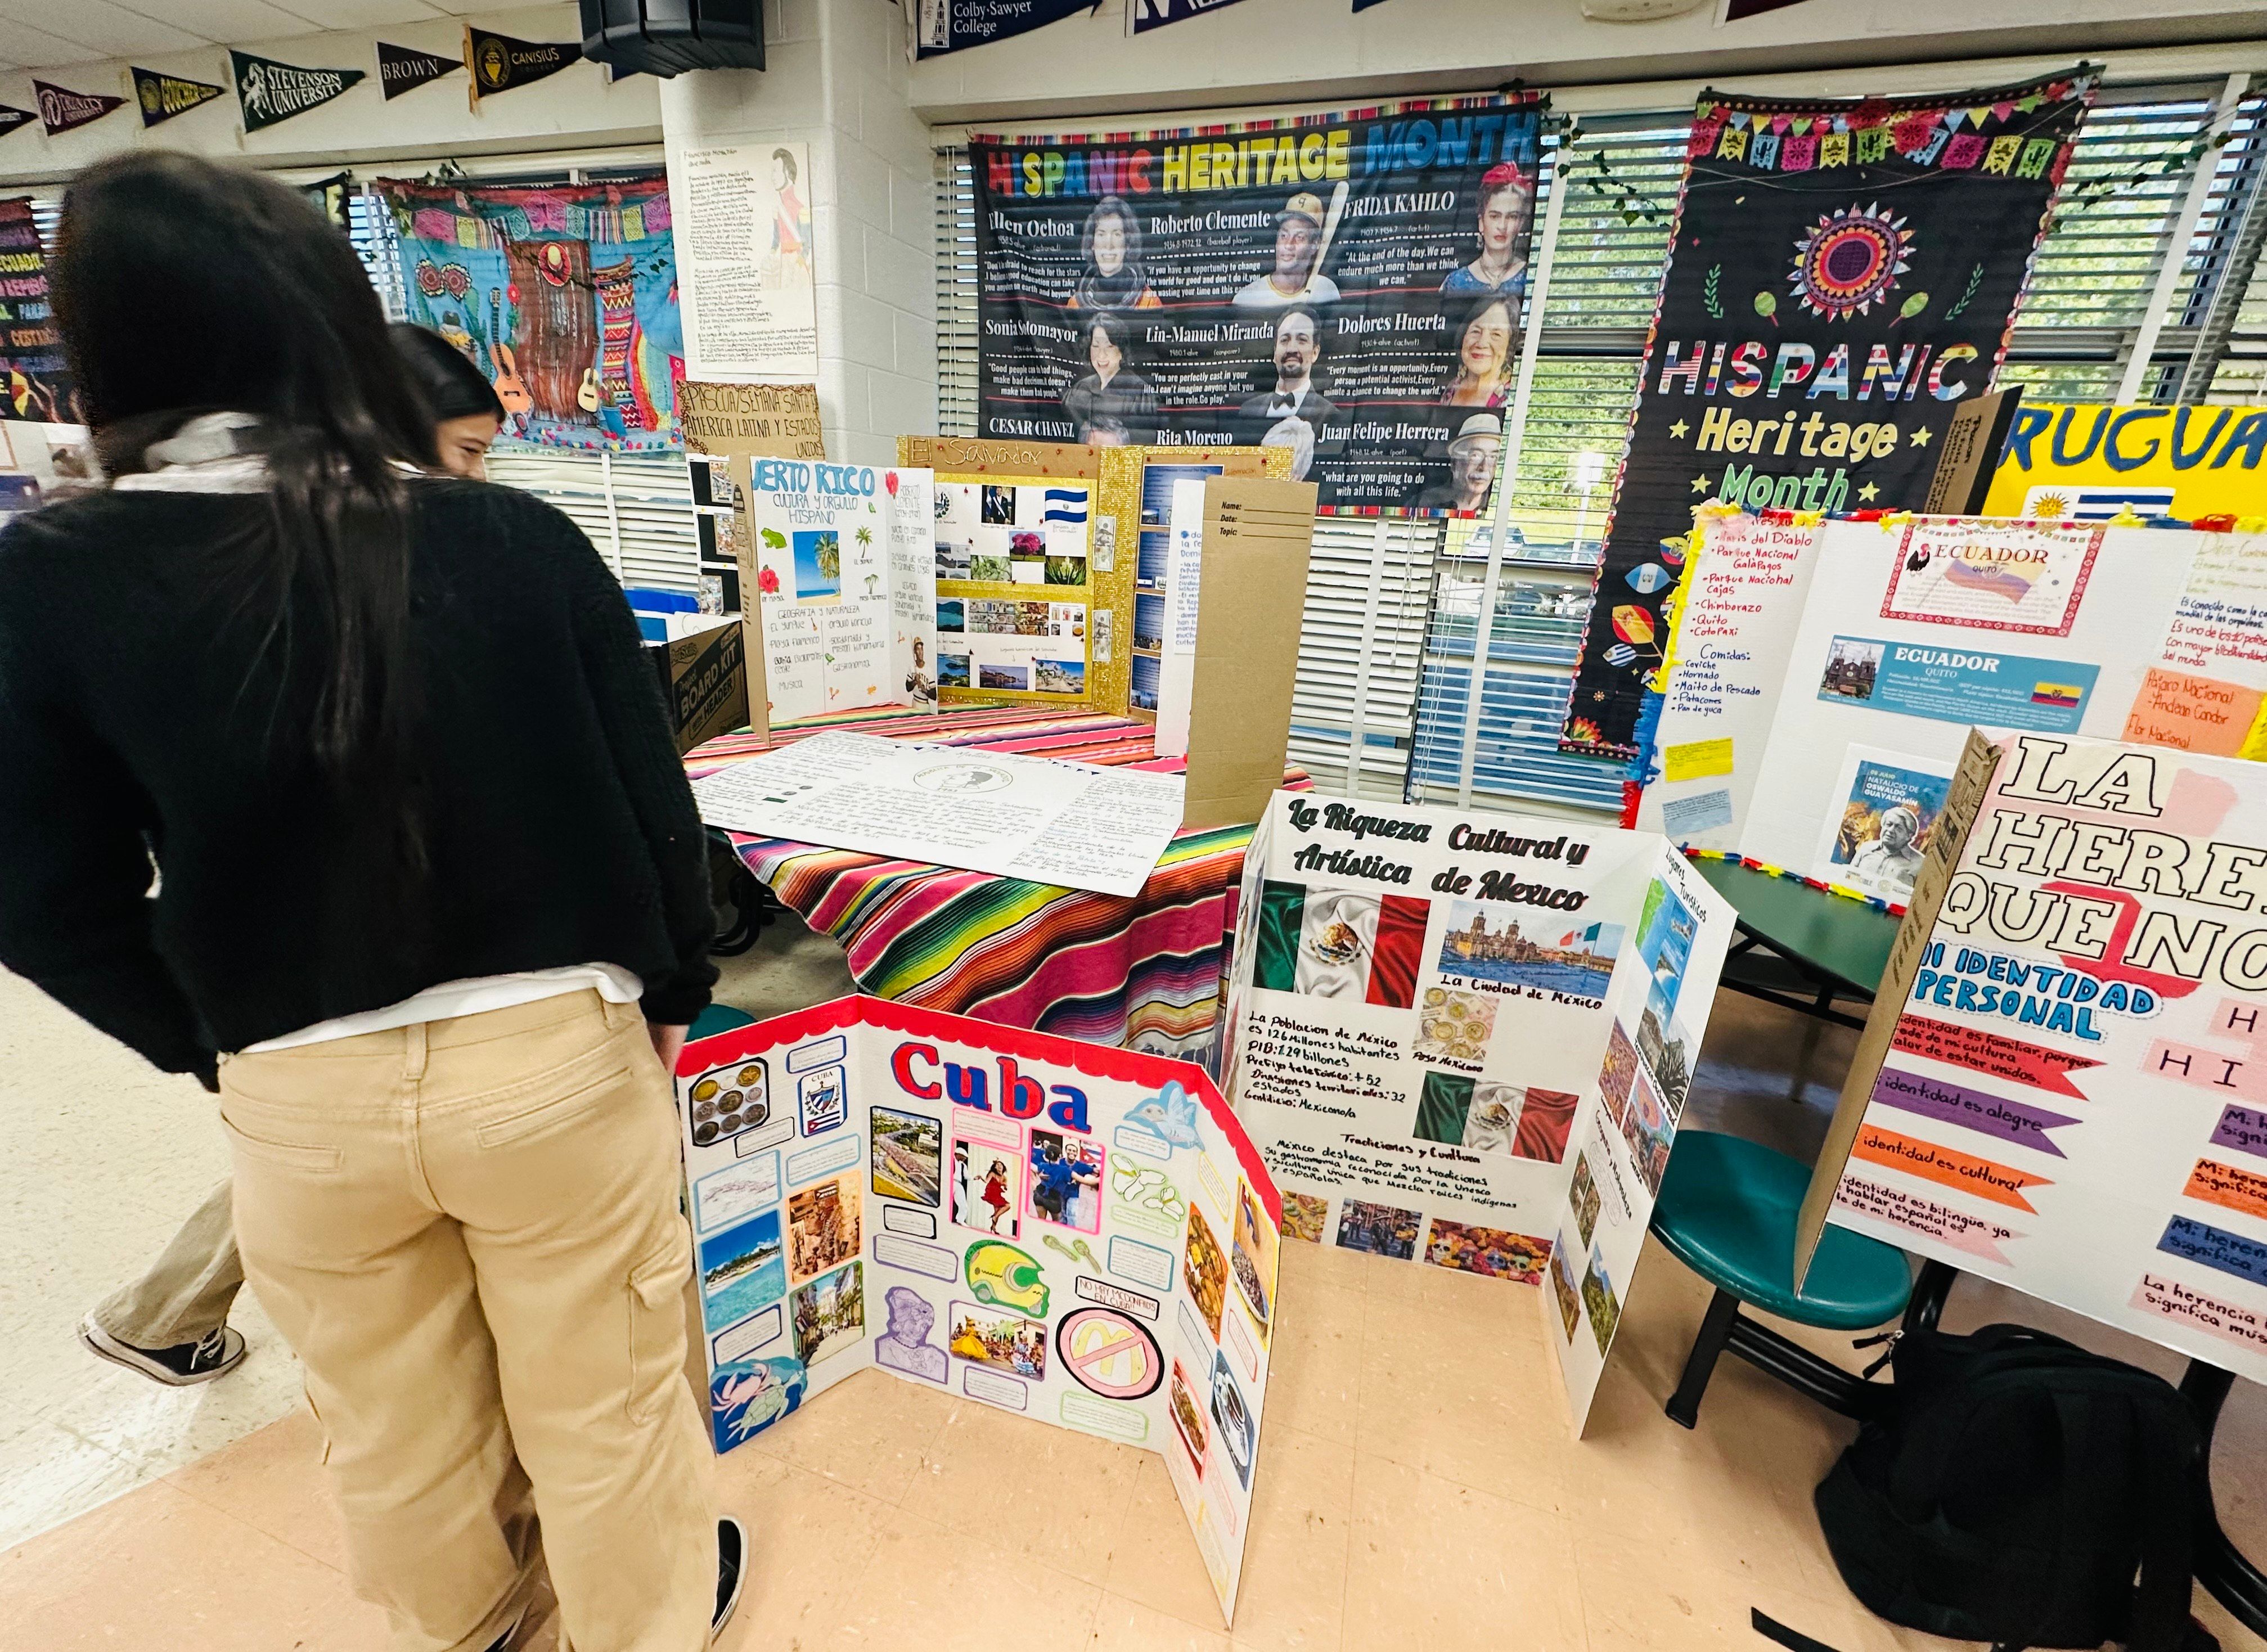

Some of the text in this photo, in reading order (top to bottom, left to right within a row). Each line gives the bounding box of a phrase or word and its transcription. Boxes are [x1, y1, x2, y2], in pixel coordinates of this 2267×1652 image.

[953, 19, 997, 36] College
[511, 47, 559, 65] CANISIUS
[267, 65, 340, 87] STEVENSON
[383, 58, 439, 80] BROWN
[271, 82, 342, 114] UNIVERSITY
[987, 112, 1539, 197] HISPANIC HERITAGE MONTH
[1343, 191, 1455, 219] FRIDA KAHLO
[1027, 218, 1074, 237] Ochoa
[1151, 210, 1271, 235] Roberto Clemente
[986, 319, 1078, 343] Sonia Sotomayor
[1146, 321, 1274, 343] Lin-Manuel Miranda
[1338, 313, 1446, 334] Dolores Huerta
[1167, 374, 1178, 382] are
[1179, 372, 1208, 383] perfectly
[1210, 372, 1222, 381] cast
[1224, 371, 1231, 380] in
[1232, 371, 1248, 381] your
[1657, 341, 1978, 401] HISPANIC
[1159, 384, 1176, 393] can't
[1177, 383, 1203, 393] imagine
[1204, 383, 1227, 393] anyone
[1229, 382, 1240, 391] but
[1242, 383, 1254, 392] you
[784, 393, 810, 413] SANTA
[1166, 396, 1172, 404] in
[1173, 395, 1184, 404] the
[686, 416, 820, 438] AMERICA LATINA Y ESTADOS
[989, 417, 1074, 438] CESAR CHAVEZ
[1156, 429, 1233, 445] Rita Moreno
[1318, 422, 1449, 443] Juan Felipe Herrera
[1695, 407, 1898, 463] Heritage
[1996, 407, 2267, 472] RUGUA
[911, 438, 1044, 466] El Salvador
[815, 461, 875, 496] RICO
[1347, 474, 1358, 483] are
[1360, 473, 1375, 484] you
[1378, 472, 1401, 484] going
[1404, 472, 1413, 482] to
[1415, 472, 1424, 483] do
[1719, 463, 1848, 510] Month
[773, 493, 809, 509] CULTURA
[823, 496, 858, 511] ORGULLO
[1336, 487, 1351, 496] with
[1353, 487, 1364, 496] all
[1366, 487, 1383, 497] this
[1221, 501, 1242, 510] Name:
[789, 510, 835, 525] HISPANO
[1220, 514, 1237, 523] Date:
[1220, 528, 1237, 536] Topic:
[1752, 532, 1812, 546] del Diablo
[1755, 548, 1799, 561] Nacional
[1935, 544, 2050, 565] ECUADOR
[1748, 574, 1793, 585] Nacional
[1972, 564, 1998, 574] QUITO
[1701, 599, 1762, 613] Chimborazo
[1697, 614, 1728, 625] Quito
[1894, 646, 2000, 673] ECUADOR
[681, 642, 737, 719] BOARD KIT
[1925, 667, 1958, 678] QUITO
[704, 677, 732, 717] HEADER
[1711, 683, 1722, 692] de
[2184, 679, 2235, 704] Nacional
[1999, 736, 2163, 817] LA
[1866, 782, 1906, 796] OSWALDO
[1288, 799, 1590, 867] La Riqueza Cultural y
[1977, 809, 2267, 911] HERE
[1294, 843, 1590, 912] Artística de Mexico
[1938, 872, 2115, 960] QUE
[1441, 974, 1463, 987] La
[1471, 979, 1521, 995] Ciudad
[1527, 989, 1542, 1000] de
[1955, 948, 2154, 1014] IDENTIDAD
[1915, 969, 2102, 1042] PERSONAL
[1249, 1011, 1266, 1023] La
[1335, 1028, 1350, 1039] de
[1249, 1025, 1262, 1034] es
[1338, 1041, 1400, 1060] habitantes
[812, 1071, 833, 1082] CUBA
[890, 1041, 1092, 1135] Cuba
[1884, 1077, 2043, 1132] identidad es alegre
[1863, 1136, 1935, 1163] identidad
[1936, 1158, 1955, 1171] es
[1079, 1279, 1092, 1290] NO
[1094, 1284, 1110, 1296] HAY
[1094, 1293, 1106, 1304] EN
